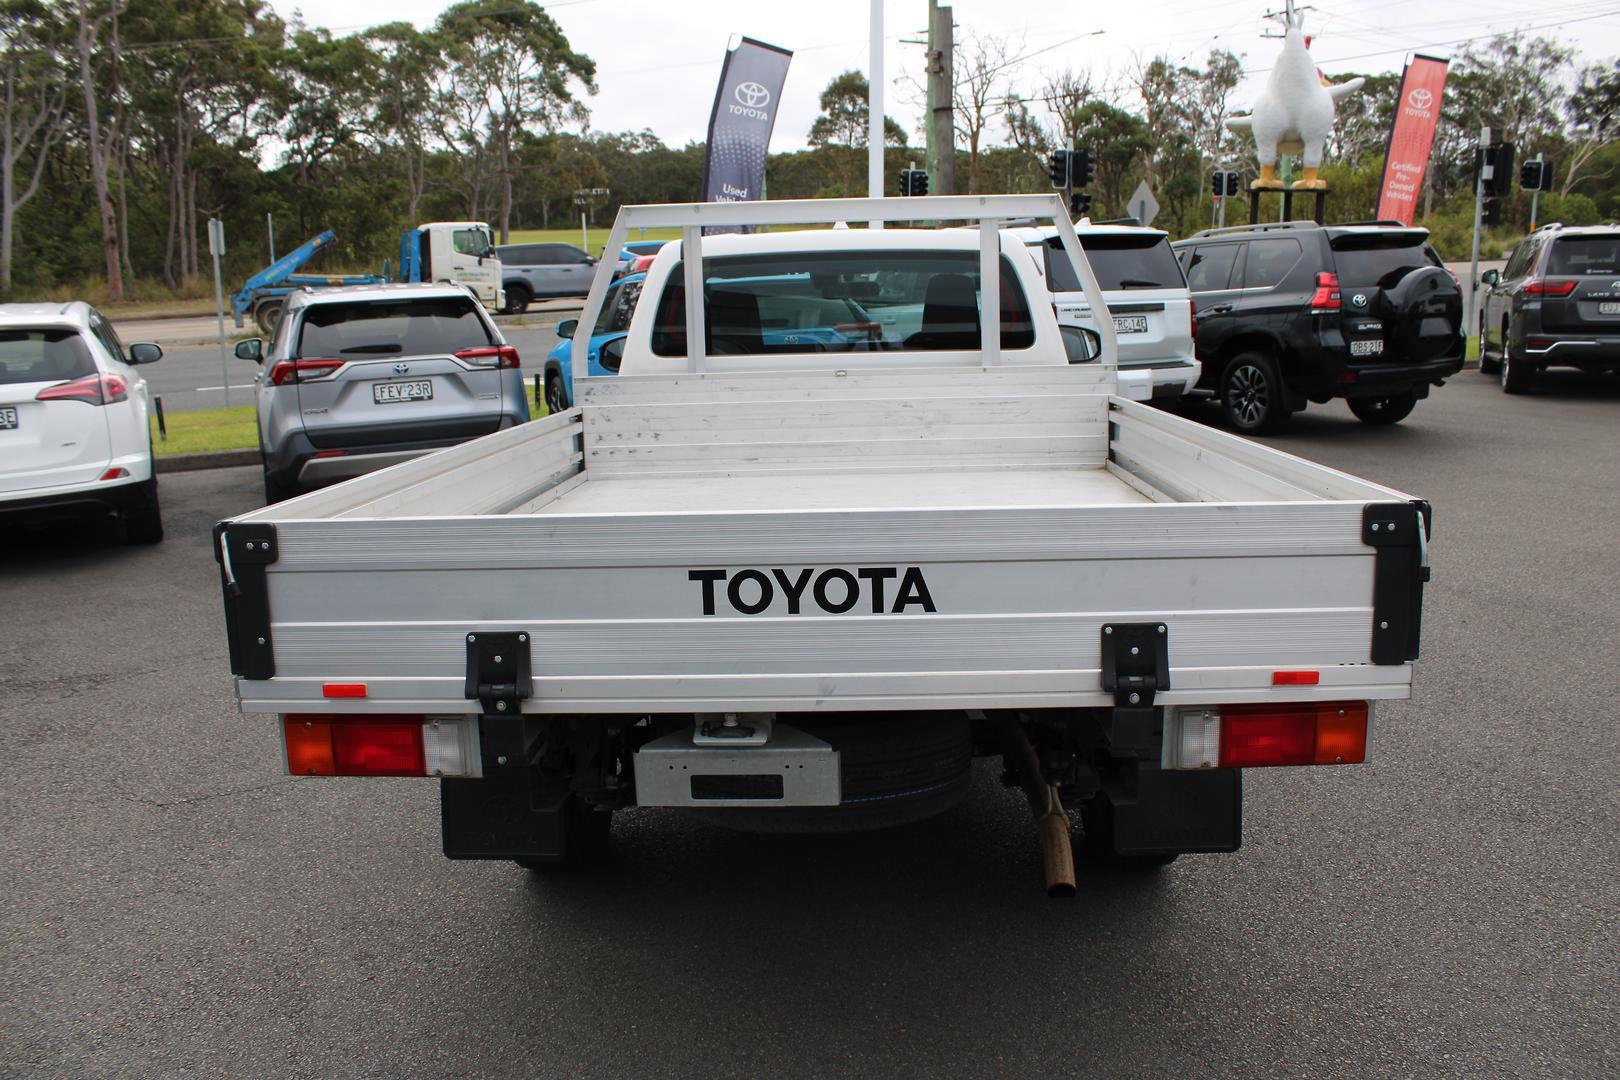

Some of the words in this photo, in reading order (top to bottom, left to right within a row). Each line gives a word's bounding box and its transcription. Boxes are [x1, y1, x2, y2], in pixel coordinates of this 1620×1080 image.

[729, 104, 768, 121] TOYOTA
[1405, 108, 1431, 119] TOYOTA
[1392, 162, 1420, 173] Certified
[1396, 171, 1411, 181] Pre-
[723, 183, 748, 198] Used
[1389, 182, 1415, 192] Owned
[1387, 191, 1413, 202] Vehicles
[688, 567, 937, 615] TOYOTA
